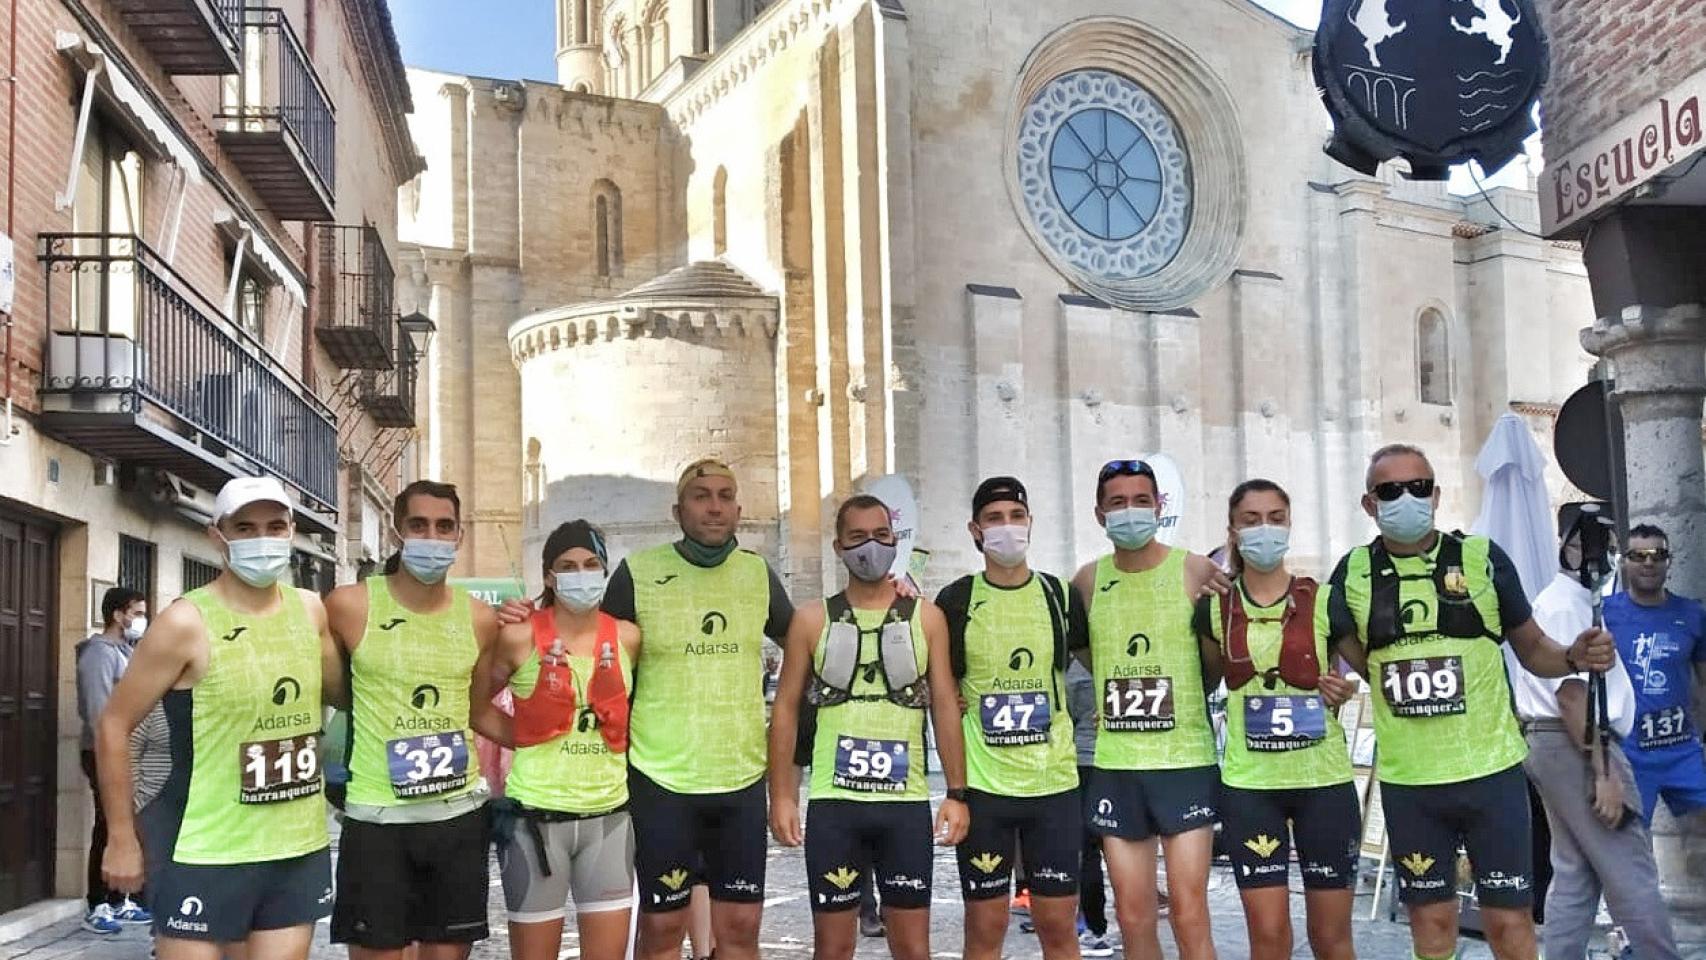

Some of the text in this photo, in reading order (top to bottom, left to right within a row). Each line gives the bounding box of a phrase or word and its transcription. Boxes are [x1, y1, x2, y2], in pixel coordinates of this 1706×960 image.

[1554, 96, 1703, 224] Escuela
[684, 641, 739, 656] Adarsa
[992, 677, 1043, 690] Adarsa
[1113, 664, 1163, 677] Adarsa
[1384, 668, 1458, 704] 109
[992, 704, 1035, 732] 47
[1106, 689, 1167, 719] 127
[251, 712, 312, 733] Adarsa
[393, 716, 451, 730] Adarsa
[1270, 708, 1295, 737] 5
[1641, 706, 1685, 739] 137
[245, 747, 317, 788] 119
[405, 746, 454, 781] 32
[847, 749, 893, 779] 59
[166, 916, 209, 933] Adarsa
